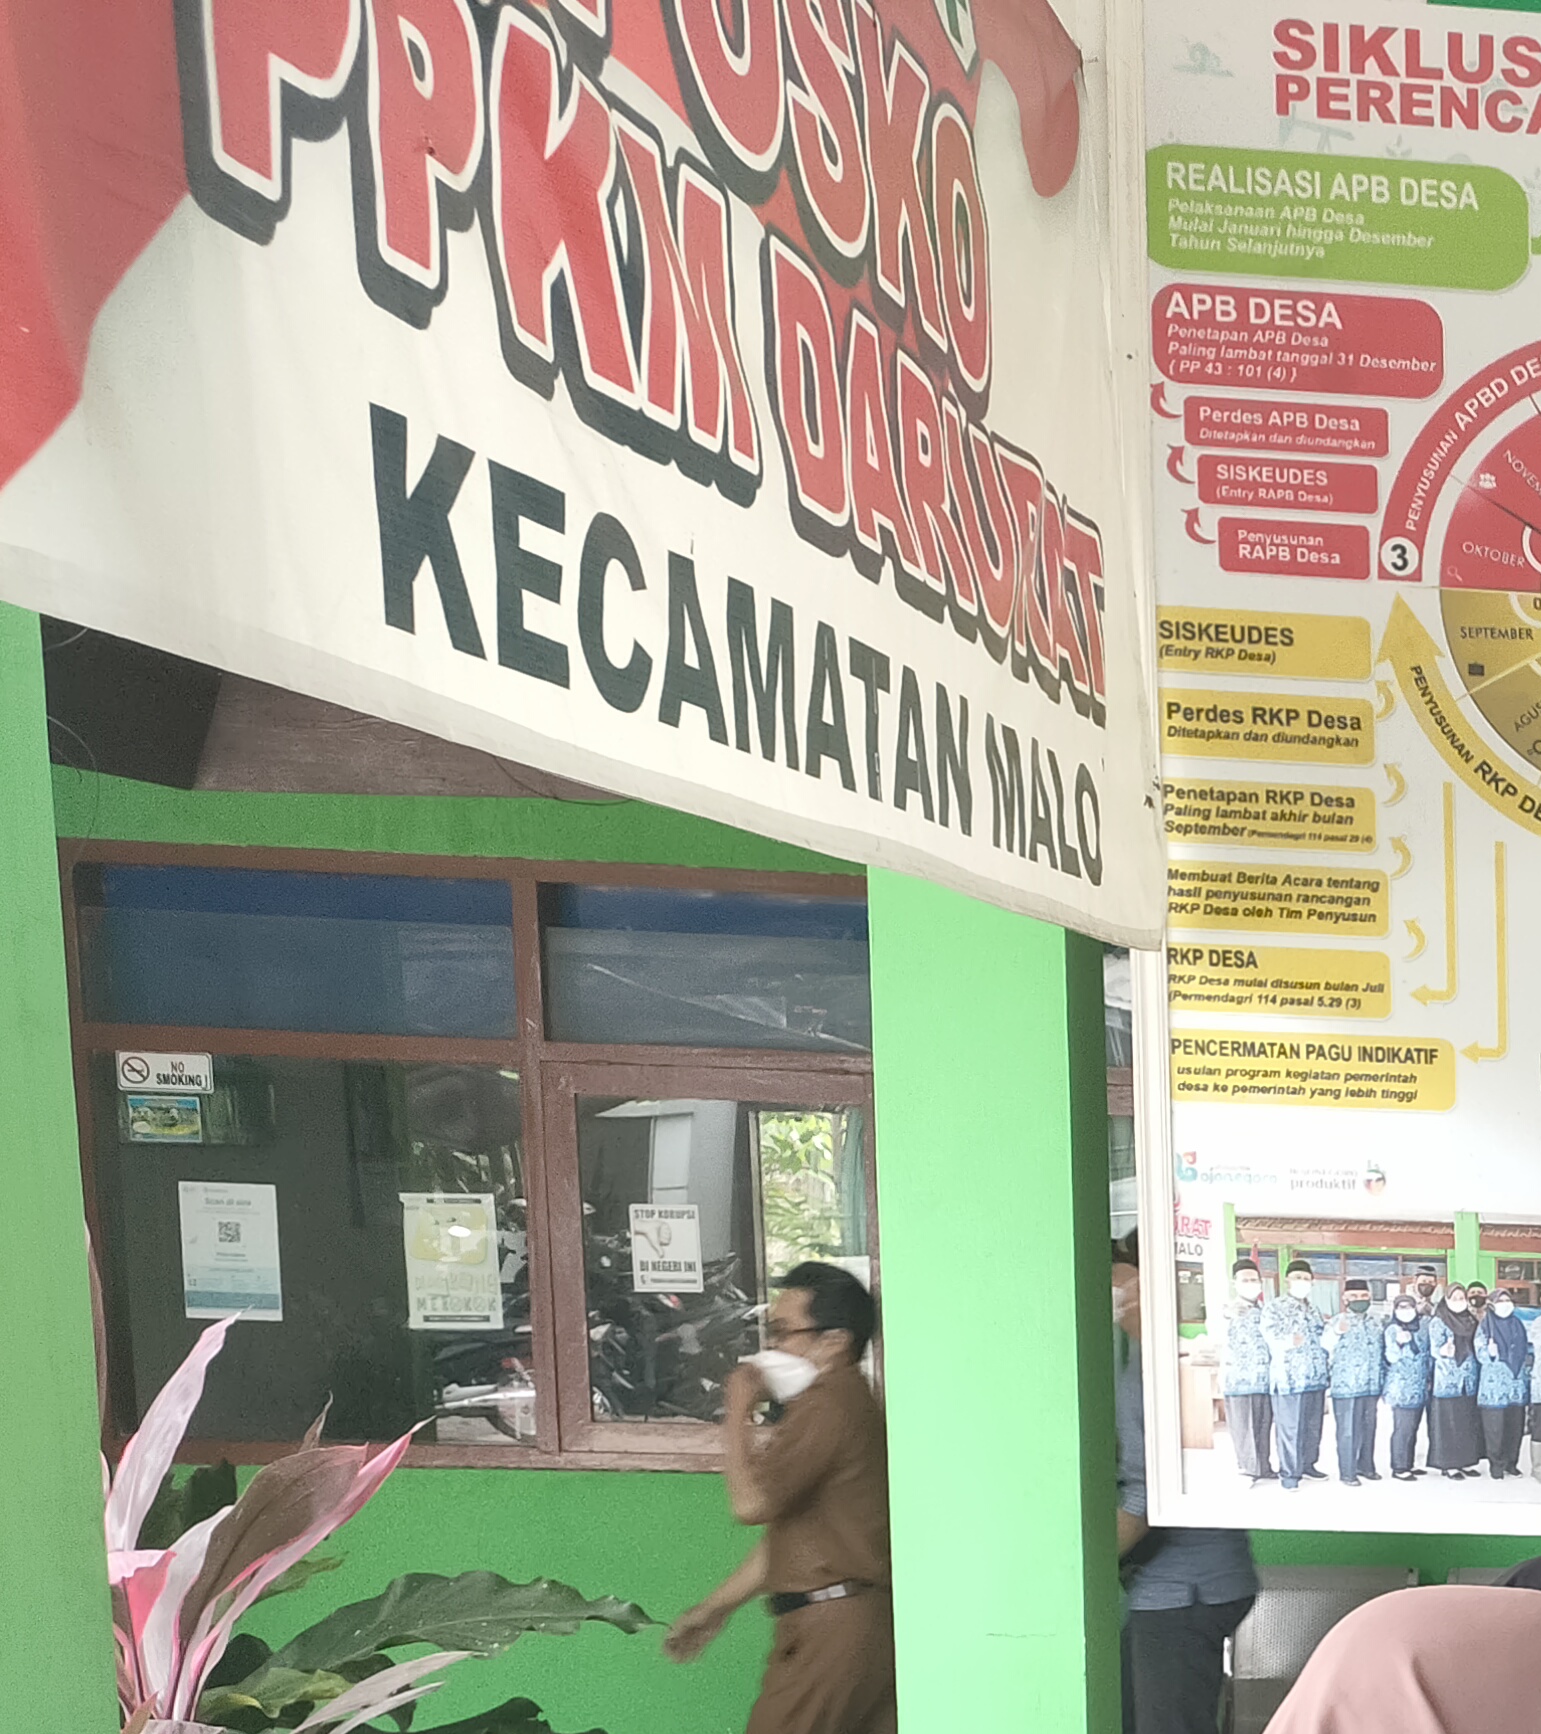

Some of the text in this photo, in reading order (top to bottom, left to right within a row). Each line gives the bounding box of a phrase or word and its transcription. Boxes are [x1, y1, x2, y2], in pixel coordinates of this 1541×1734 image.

[1166, 162, 1480, 211] REALISASI APB DESA
[1279, 205, 1318, 223] APB
[1322, 208, 1365, 226] Desa
[1217, 219, 1282, 238] Januari
[1349, 227, 1434, 248] Desember
[1169, 234, 1325, 259] Tahun Selanjutnya
[1166, 291, 1343, 330] APB DESA
[1167, 323, 1329, 348] Penetapan APB Desa
[1168, 341, 1436, 373] Paling lambat tanggal 31 Desember
[1199, 406, 1360, 432] Perdes APB Desa
[1405, 431, 1458, 531] PENYUSUNAN
[1453, 377, 1509, 431] APBD
[768, 228, 1106, 715] DARURAT
[1216, 464, 1328, 486] SISKEUDES
[1238, 529, 1324, 549] Penyusunan
[1239, 545, 1341, 565] RAPB Desa
[1391, 544, 1409, 571] 3
[1462, 541, 1525, 568] OKTOBER
[369, 401, 1102, 886] KECAMATAN MALO
[1158, 619, 1294, 646] SISKEUDES
[1460, 626, 1533, 641] SEPTEMBER
[1159, 645, 1276, 665] (Entry RKP Desa)
[1167, 702, 1362, 731] Perdes RKP Desa
[1167, 726, 1359, 749] Ditetapkan dan diundangkan
[1410, 665, 1474, 764] PENYUSUNAN
[1473, 759, 1518, 798] RKP
[1163, 784, 1356, 808] Penetapan RKP Desa
[1163, 803, 1354, 825] Paling lambat akhir bulan
[1164, 820, 1246, 838] September
[1167, 868, 1380, 892] Membuat Berita Acara tentang
[1167, 886, 1371, 907] hasil penyusunan rancangan
[1168, 902, 1377, 924] RKP Desa oleh Tim Penyusun
[1167, 947, 1258, 969] RKP DESA
[1170, 1038, 1439, 1065] PENCERMATAN PAGU INDIKATIF
[171, 1061, 185, 1073] NO
[1225, 1067, 1281, 1083] program
[634, 1209, 656, 1219] STOP
